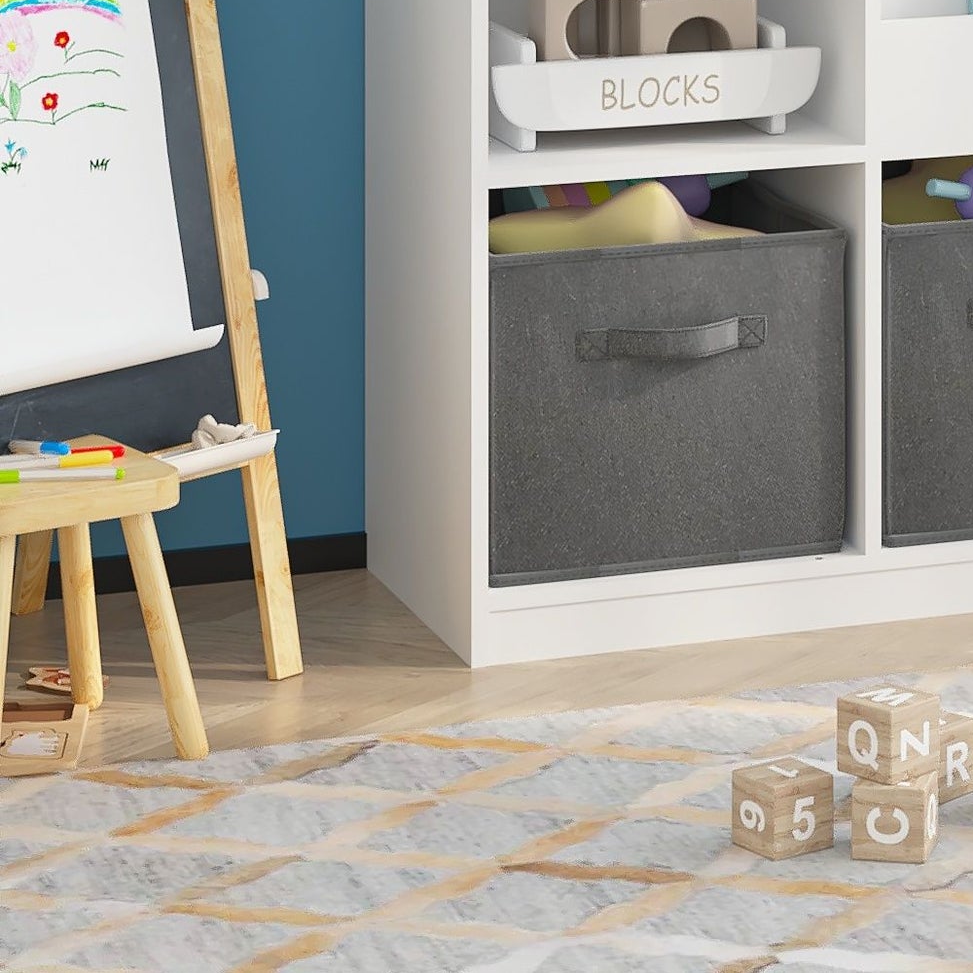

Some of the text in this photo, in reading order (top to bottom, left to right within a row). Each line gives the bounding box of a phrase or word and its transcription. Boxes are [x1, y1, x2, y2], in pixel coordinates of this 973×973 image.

[601, 74, 720, 110] BLOCKS
[848, 719, 880, 771] Q
[946, 741, 972, 788] R
[791, 795, 816, 842] 5
[866, 806, 910, 845] C
